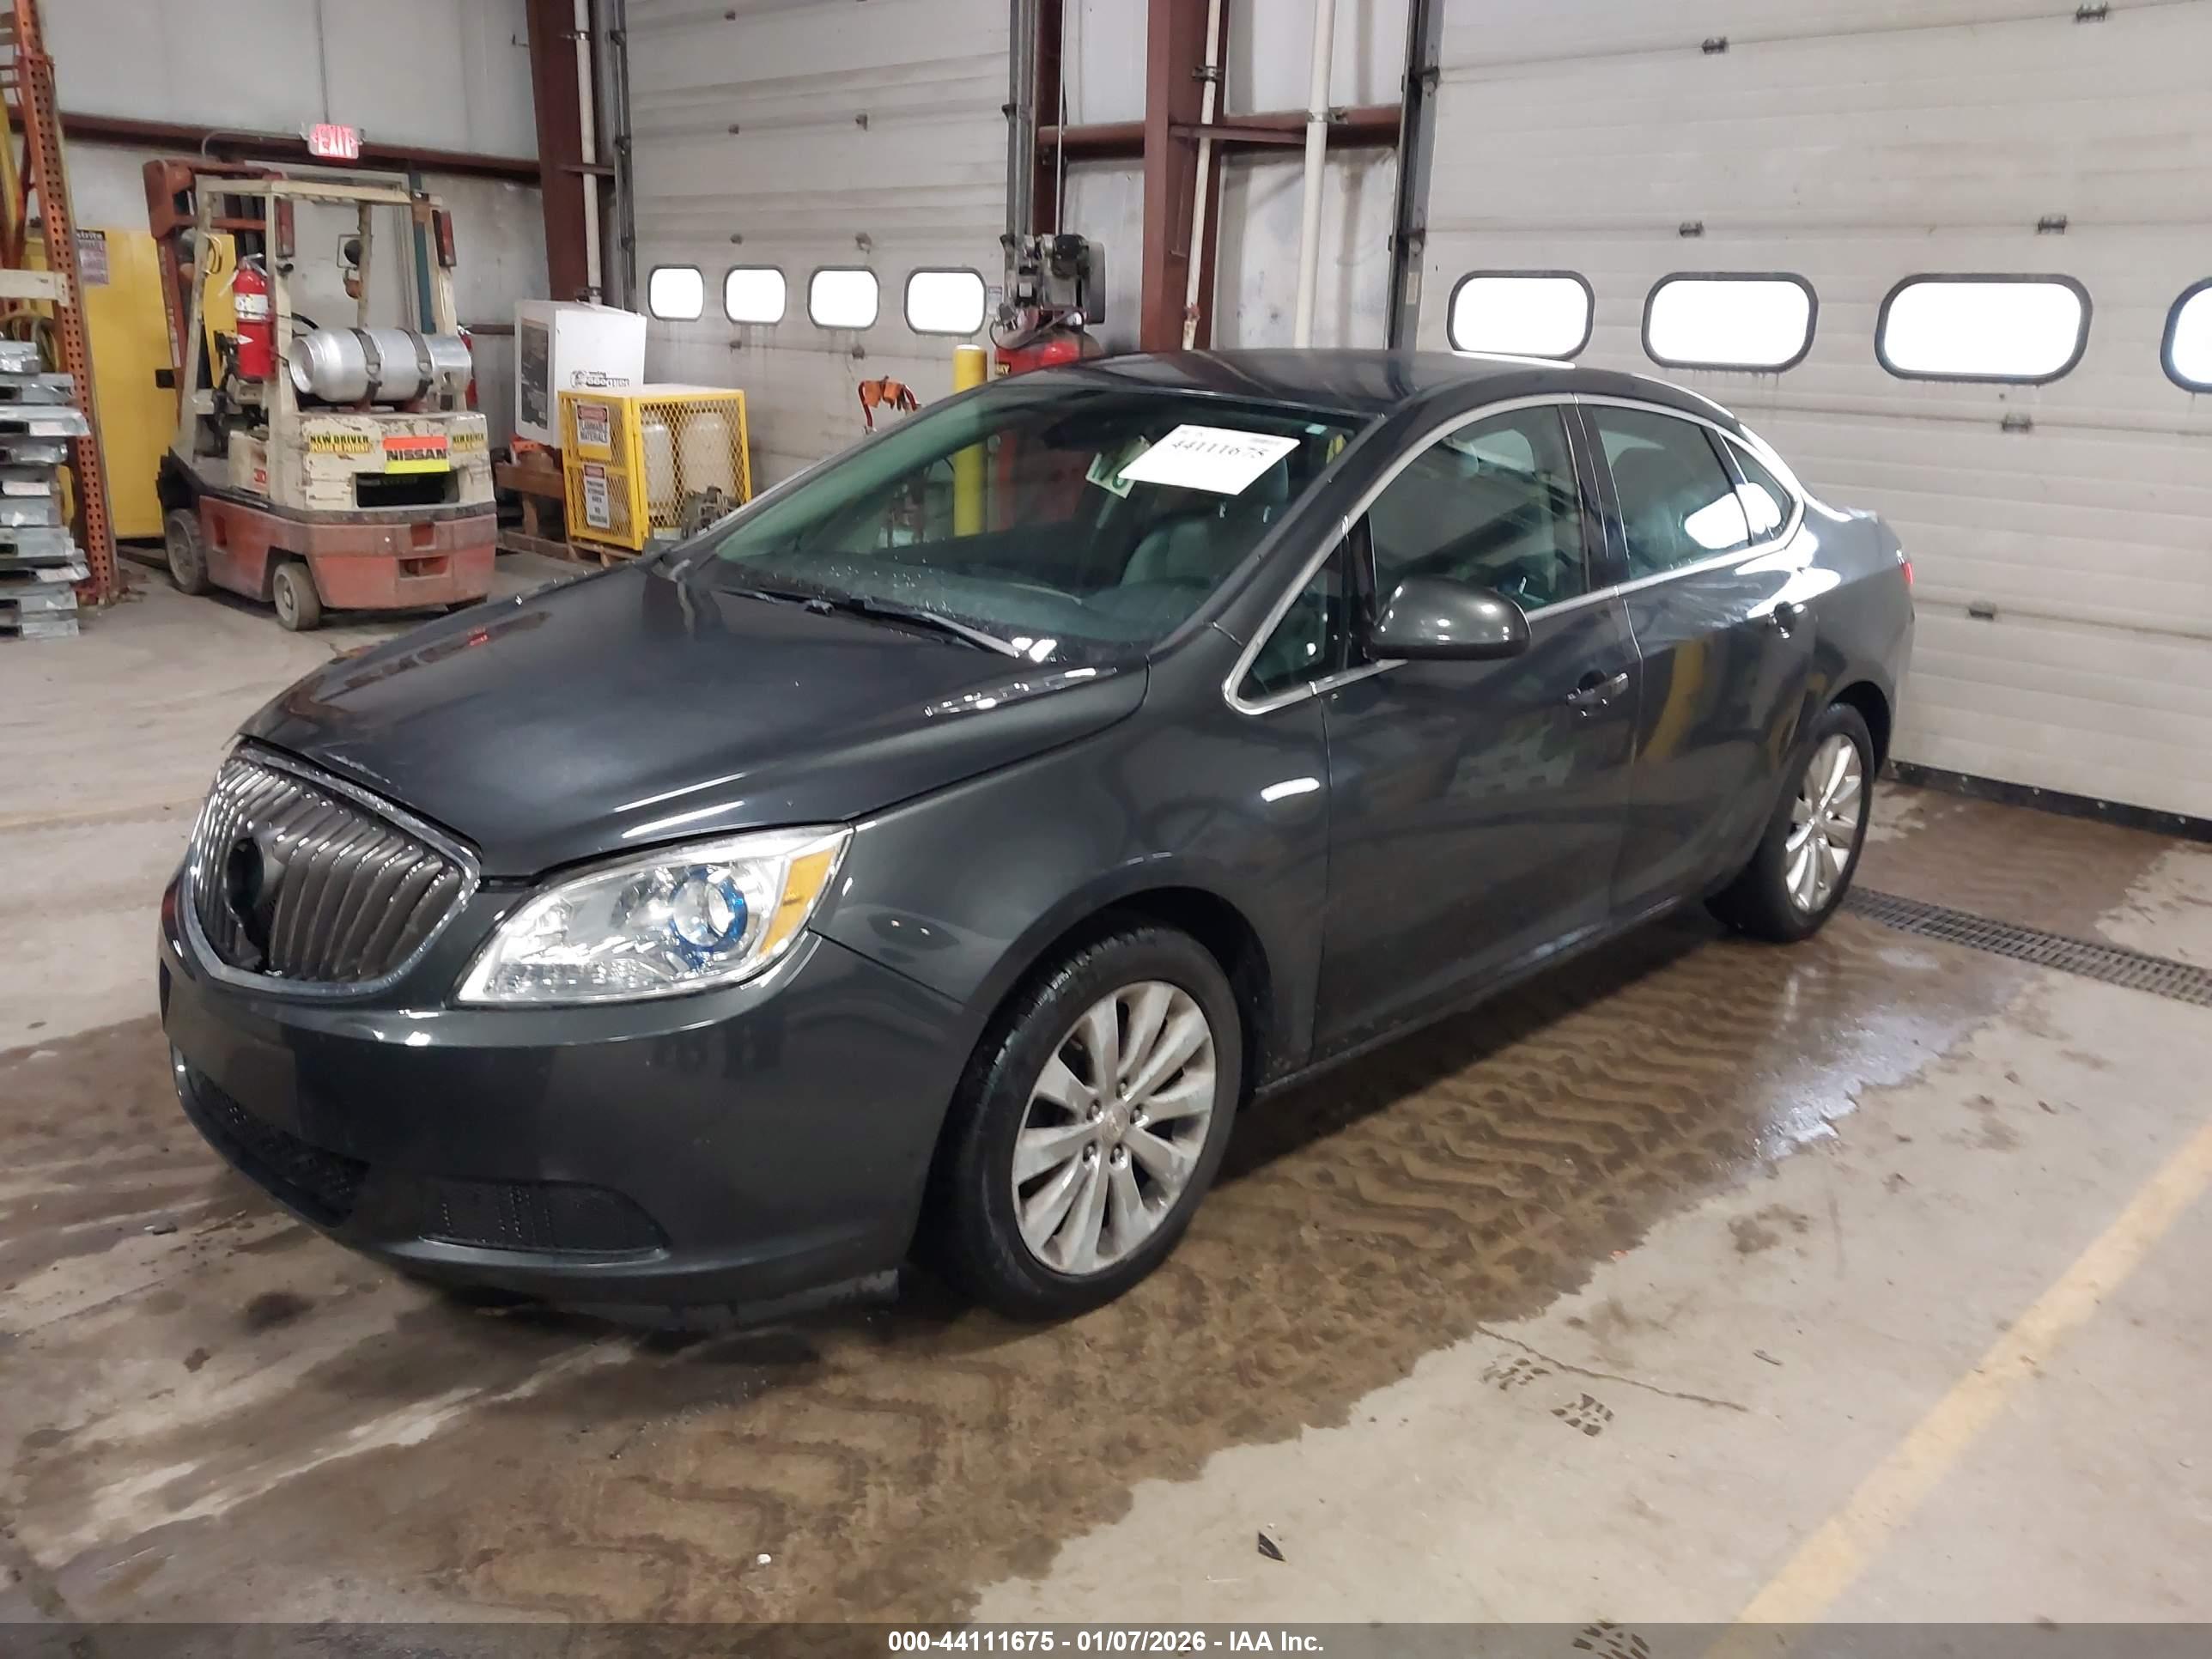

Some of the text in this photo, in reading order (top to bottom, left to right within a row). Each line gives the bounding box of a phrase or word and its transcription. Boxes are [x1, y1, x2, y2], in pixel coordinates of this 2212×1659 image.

[317, 124, 352, 157] EXIT
[309, 434, 369, 444] NEW DRIVER
[386, 449, 447, 461] NISSAN
[1170, 439, 1270, 459] 44111675
